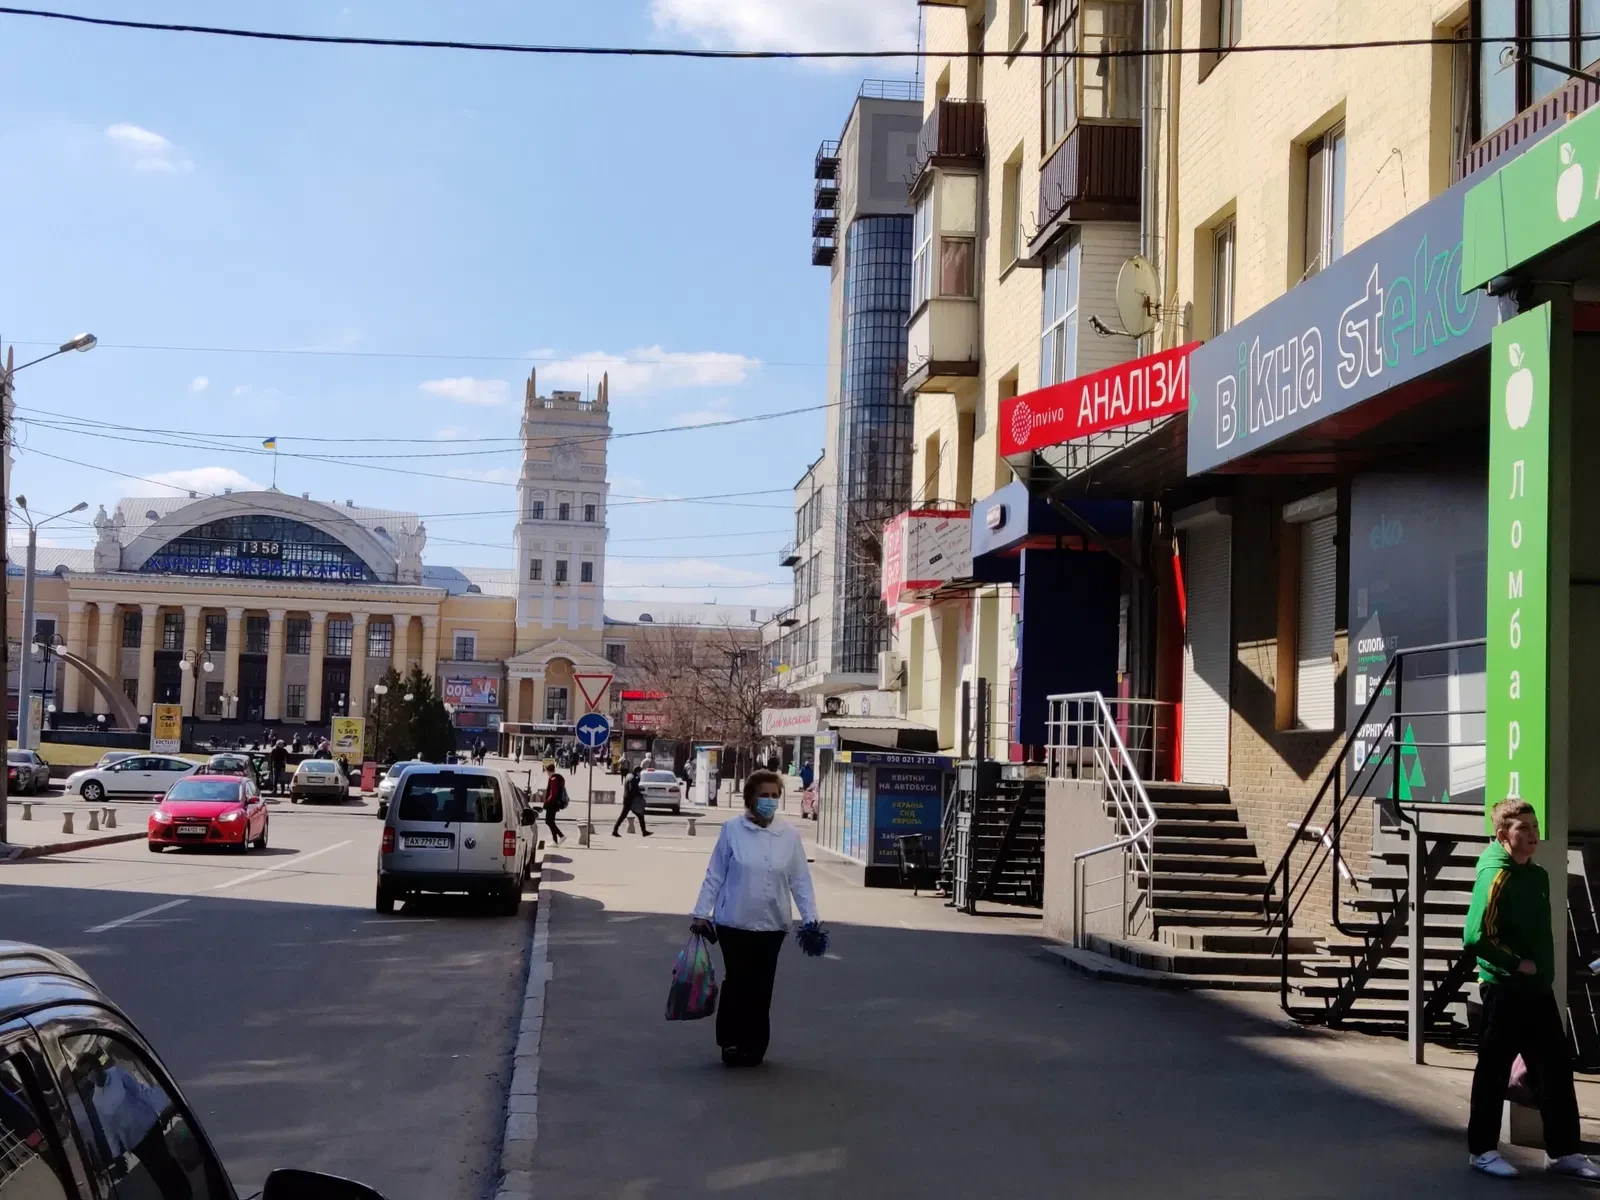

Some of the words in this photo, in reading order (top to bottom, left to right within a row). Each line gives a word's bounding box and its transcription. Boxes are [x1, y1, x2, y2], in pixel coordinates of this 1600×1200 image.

[1077, 355, 1187, 428] АНАЛІЗИ
[1032, 406, 1065, 429] invivo
[149, 556, 210, 573] ХАРКІВ
[215, 557, 301, 577] ВОКЗАЛ
[305, 562, 365, 580] ХАРКІВ
[886, 755, 900, 763] 050
[891, 774, 925, 782] КВИТКИ
[879, 782, 891, 790] НА
[894, 783, 937, 792] АВТОБУСИ
